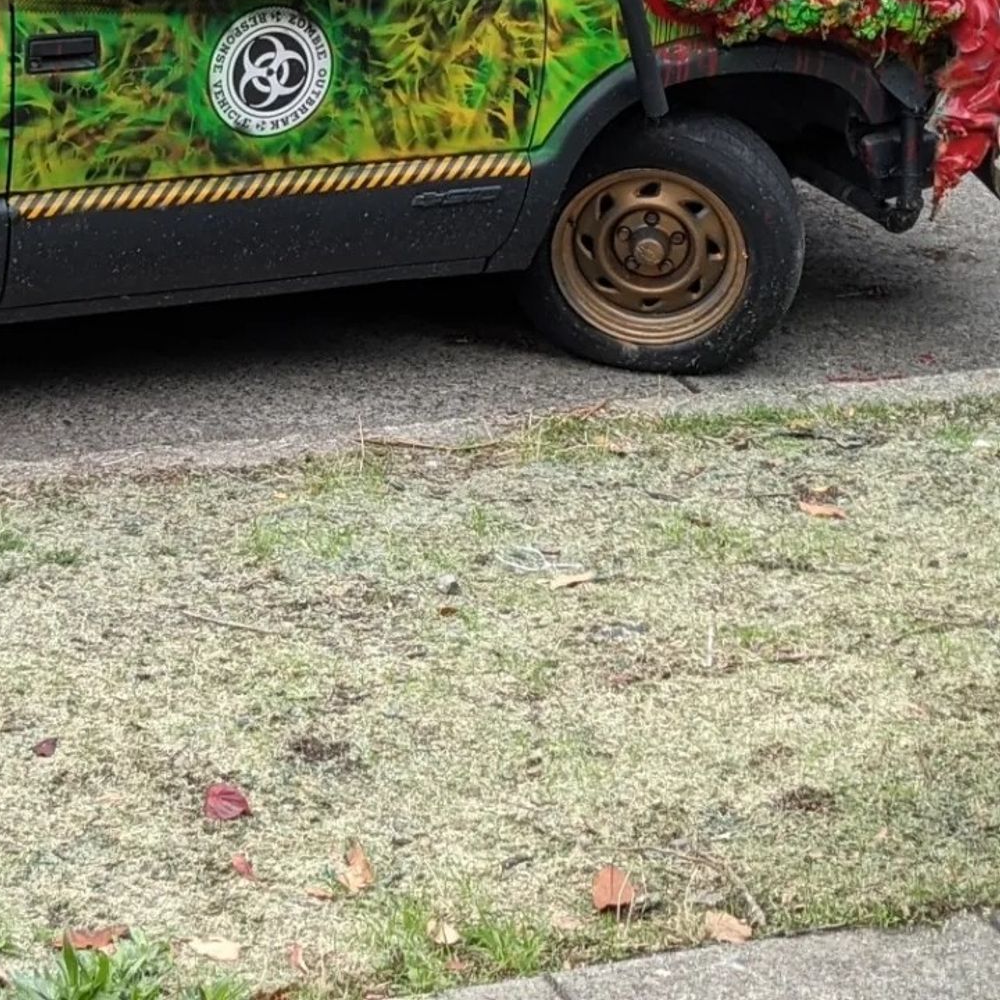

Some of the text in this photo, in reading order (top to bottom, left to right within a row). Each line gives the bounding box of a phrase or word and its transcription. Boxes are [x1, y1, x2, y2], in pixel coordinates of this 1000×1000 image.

[212, 12, 268, 129] RESPONSE VEHICLE
[270, 13, 328, 130] ZOMBIE OUTBREAK
